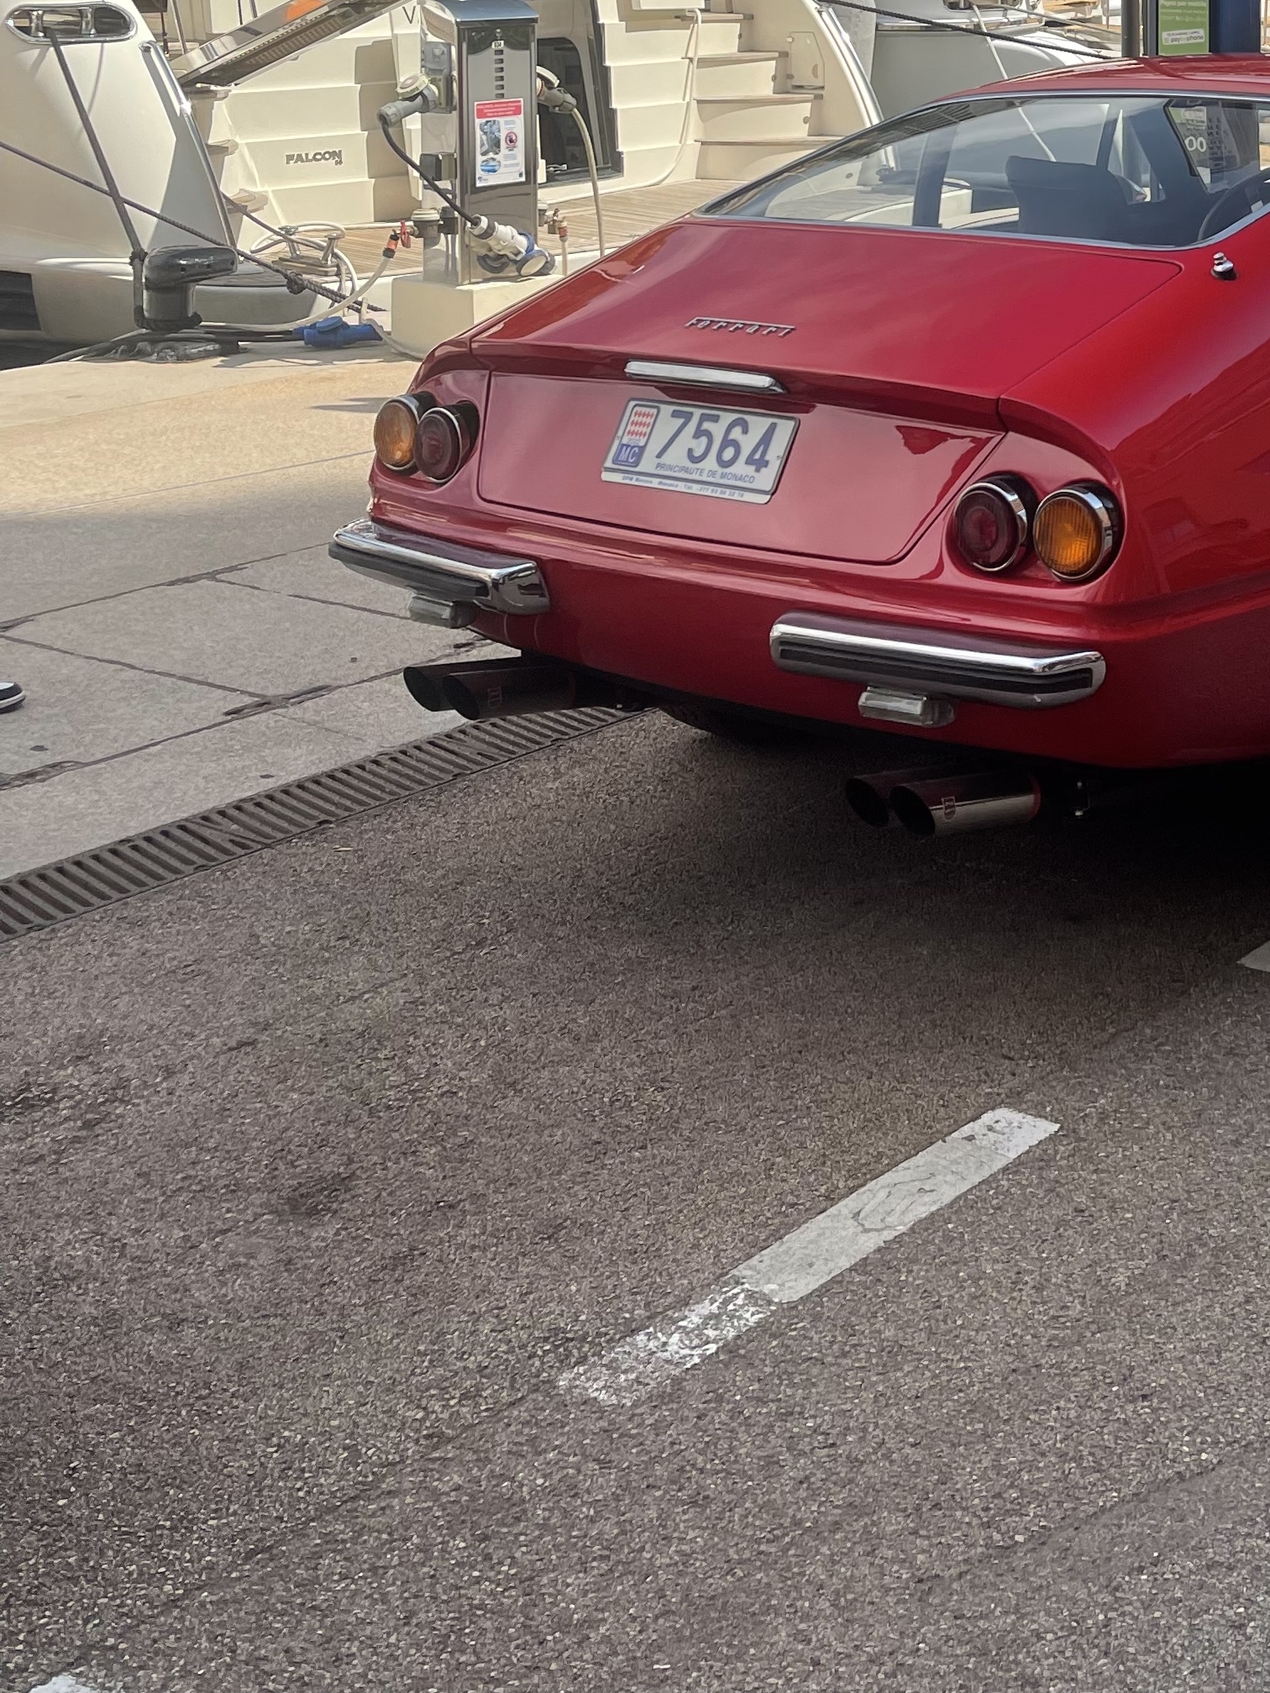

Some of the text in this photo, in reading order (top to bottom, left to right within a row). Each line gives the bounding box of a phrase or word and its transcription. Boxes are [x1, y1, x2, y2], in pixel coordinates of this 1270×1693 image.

[285, 150, 343, 165] FALCON
[684, 316, 796, 338] Ferrari
[655, 409, 778, 473] 7564
[617, 446, 639, 463] MC
[655, 462, 756, 485] PRINCIPAUTE DE MONACO
